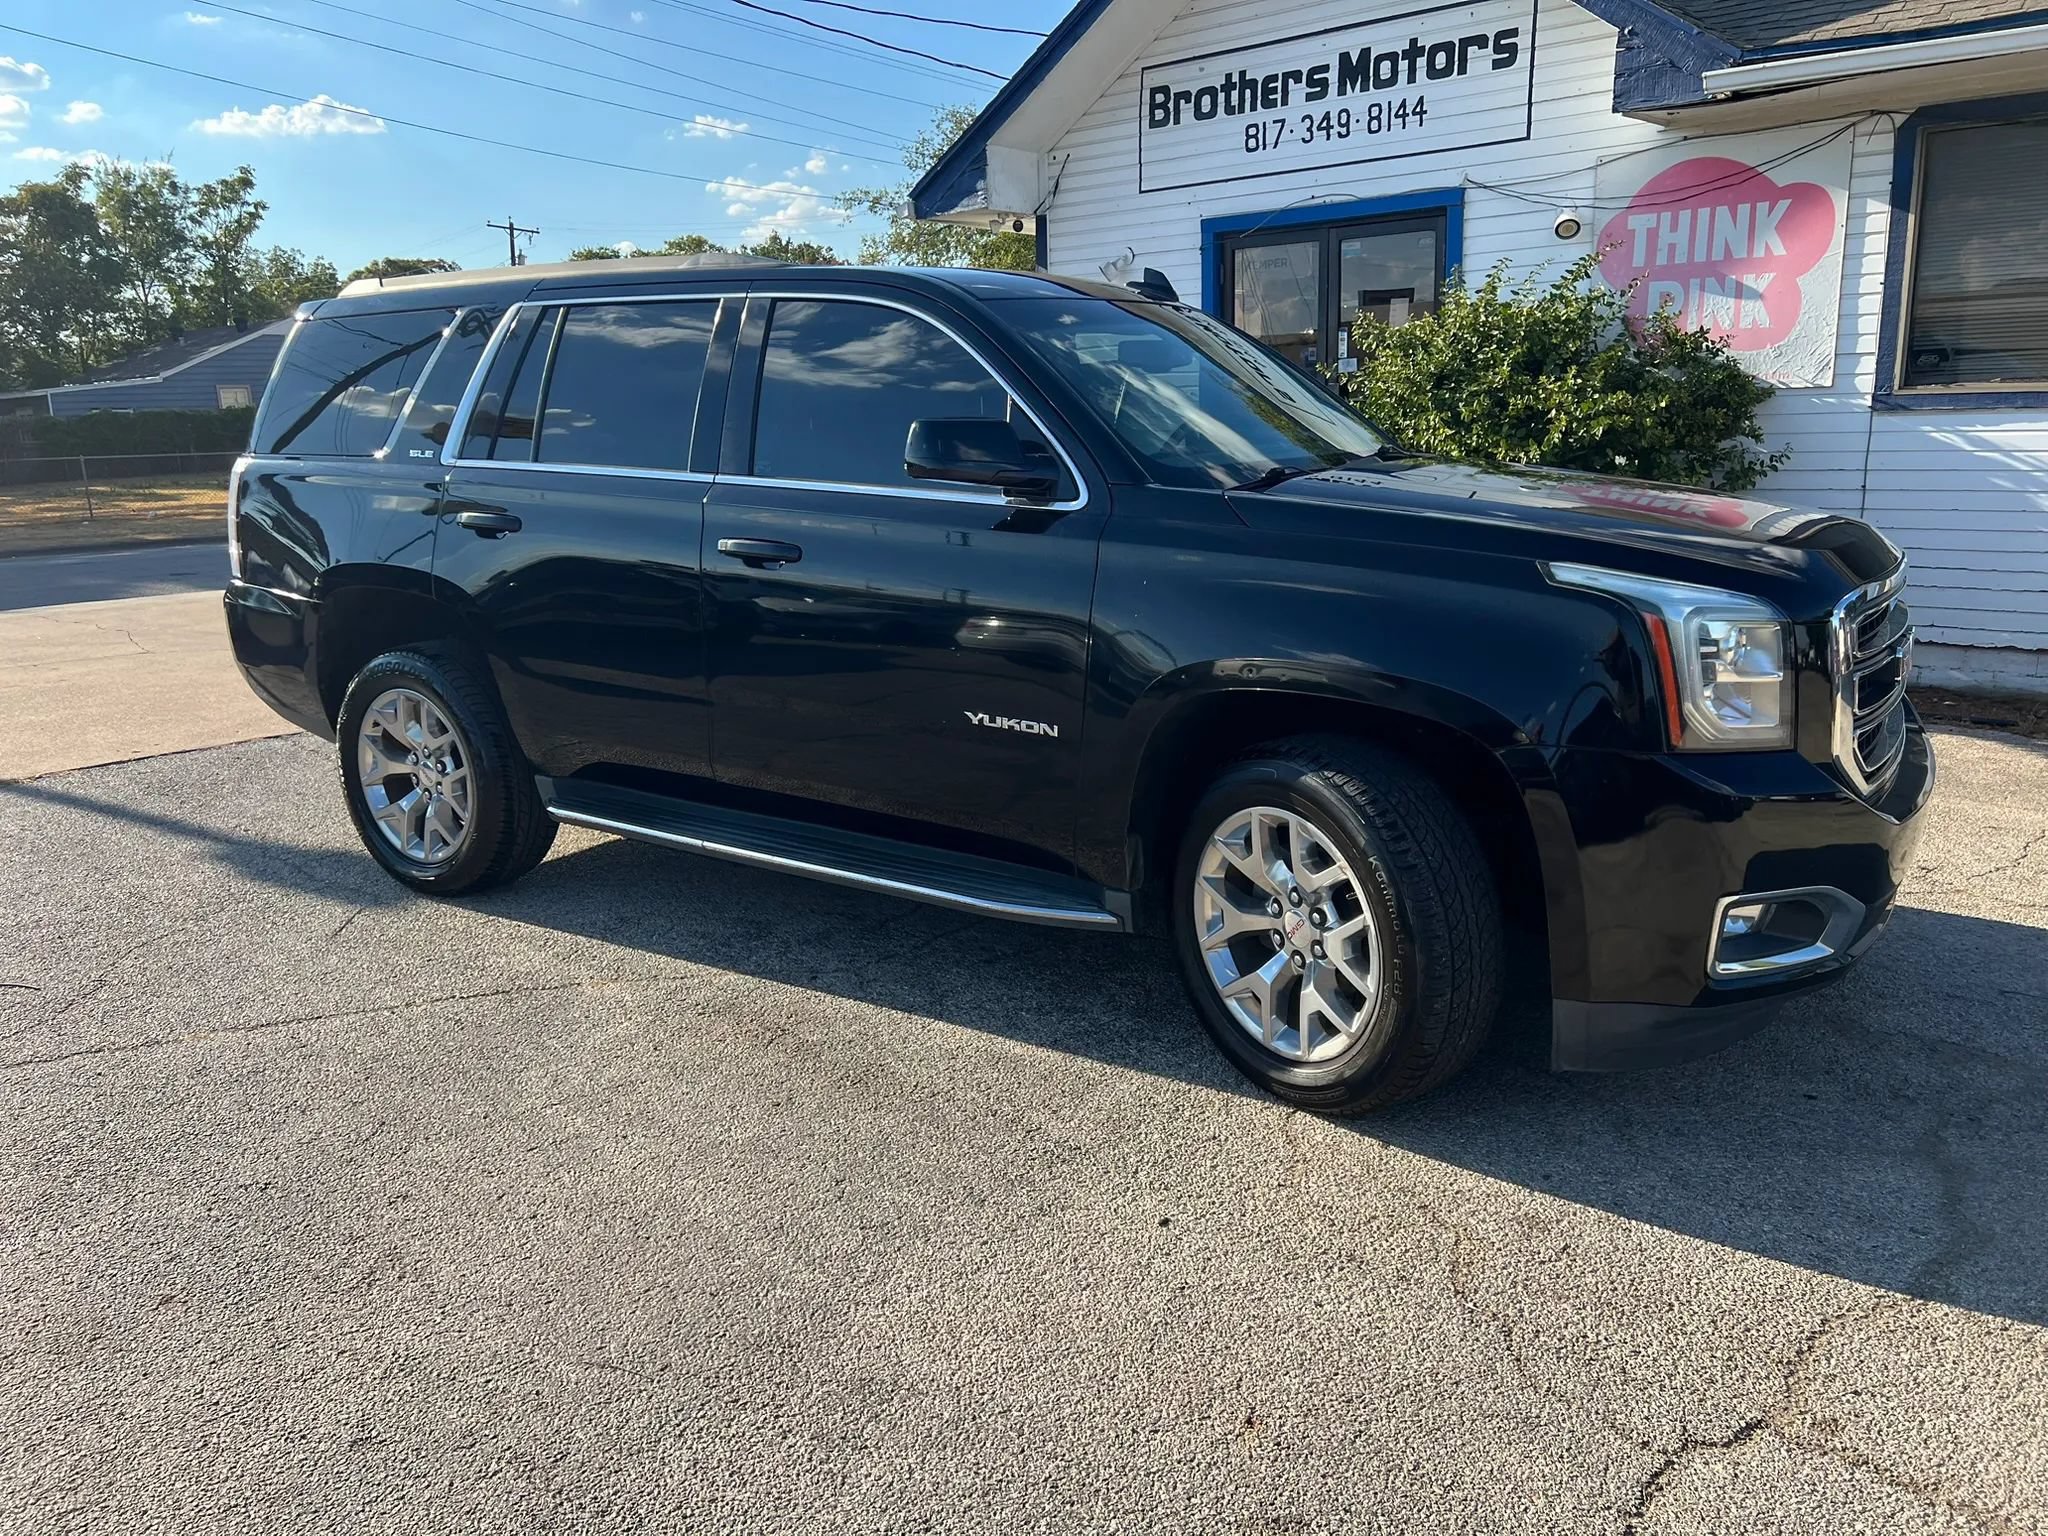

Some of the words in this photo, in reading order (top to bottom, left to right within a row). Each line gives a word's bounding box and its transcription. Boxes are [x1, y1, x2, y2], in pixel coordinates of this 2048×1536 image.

[1148, 63, 1330, 129] Brothers
[1337, 27, 1519, 97] Motors
[1627, 198, 1793, 267] THINK
[1646, 271, 1777, 333] PINK
[409, 449, 434, 458] SLE
[963, 710, 1059, 738] YUKON
